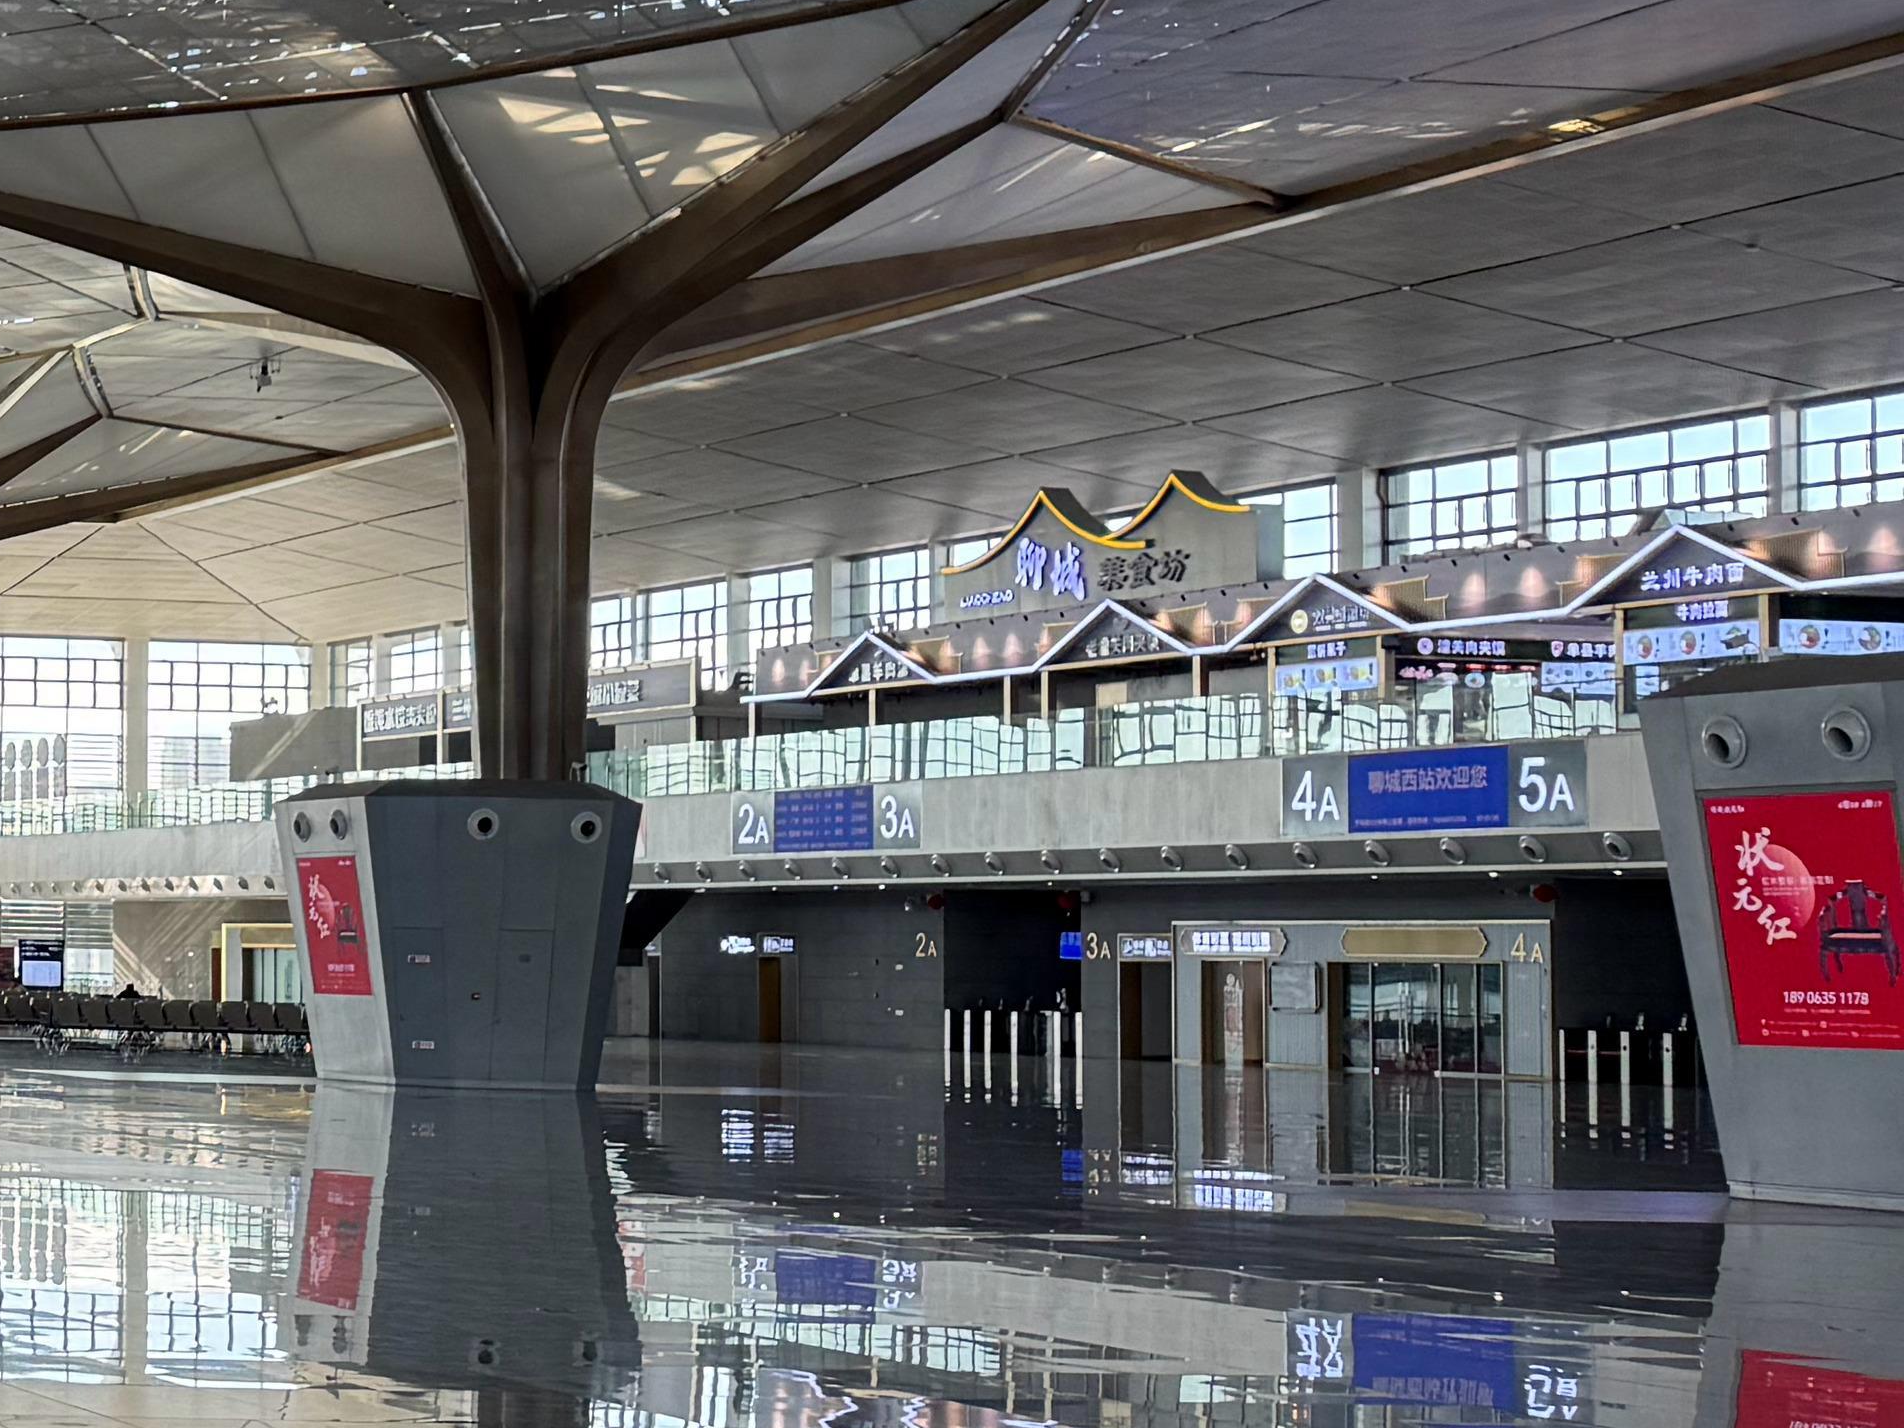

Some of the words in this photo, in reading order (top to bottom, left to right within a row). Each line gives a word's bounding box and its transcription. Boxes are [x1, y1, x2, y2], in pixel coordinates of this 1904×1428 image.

[1015, 537, 1086, 601] 聊城
[1640, 562, 1745, 591] 兰州牛肉面
[1292, 770, 1341, 821] 4A
[1368, 765, 1488, 794] 聊城西站欢迎您
[1518, 756, 1575, 812] 5A
[737, 803, 769, 844] 2A
[880, 794, 914, 839] 3A
[1733, 827, 1797, 946] 状元红
[915, 932, 937, 957] 2A
[1086, 932, 1111, 960] 3A
[1510, 932, 1544, 964] 4A
[1783, 991, 1804, 1004] 189
[1806, 991, 1836, 1005] 0635
[1840, 992, 1869, 1005] 1178
